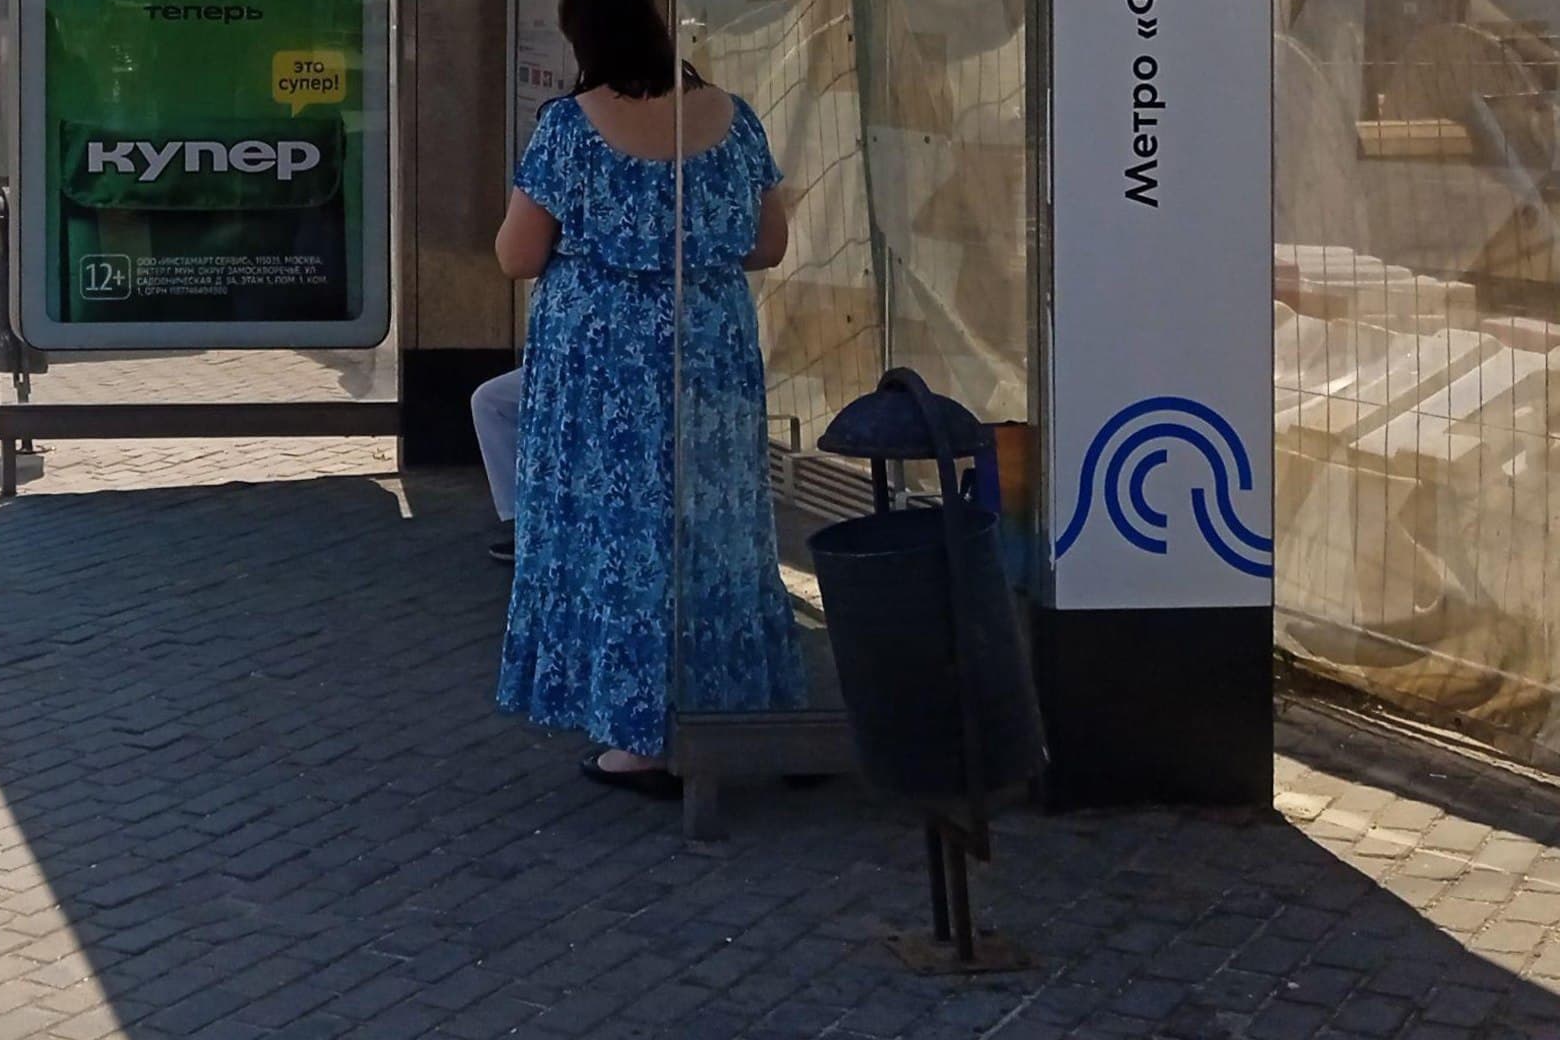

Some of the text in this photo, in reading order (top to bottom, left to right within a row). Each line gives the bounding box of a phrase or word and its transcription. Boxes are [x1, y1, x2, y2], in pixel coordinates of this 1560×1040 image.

[144, 5, 263, 25] теперь
[294, 61, 324, 73] это
[279, 75, 339, 93] супер!
[1125, 55, 1166, 207] Метро
[88, 140, 320, 181] купер
[85, 263, 126, 291] 12+
